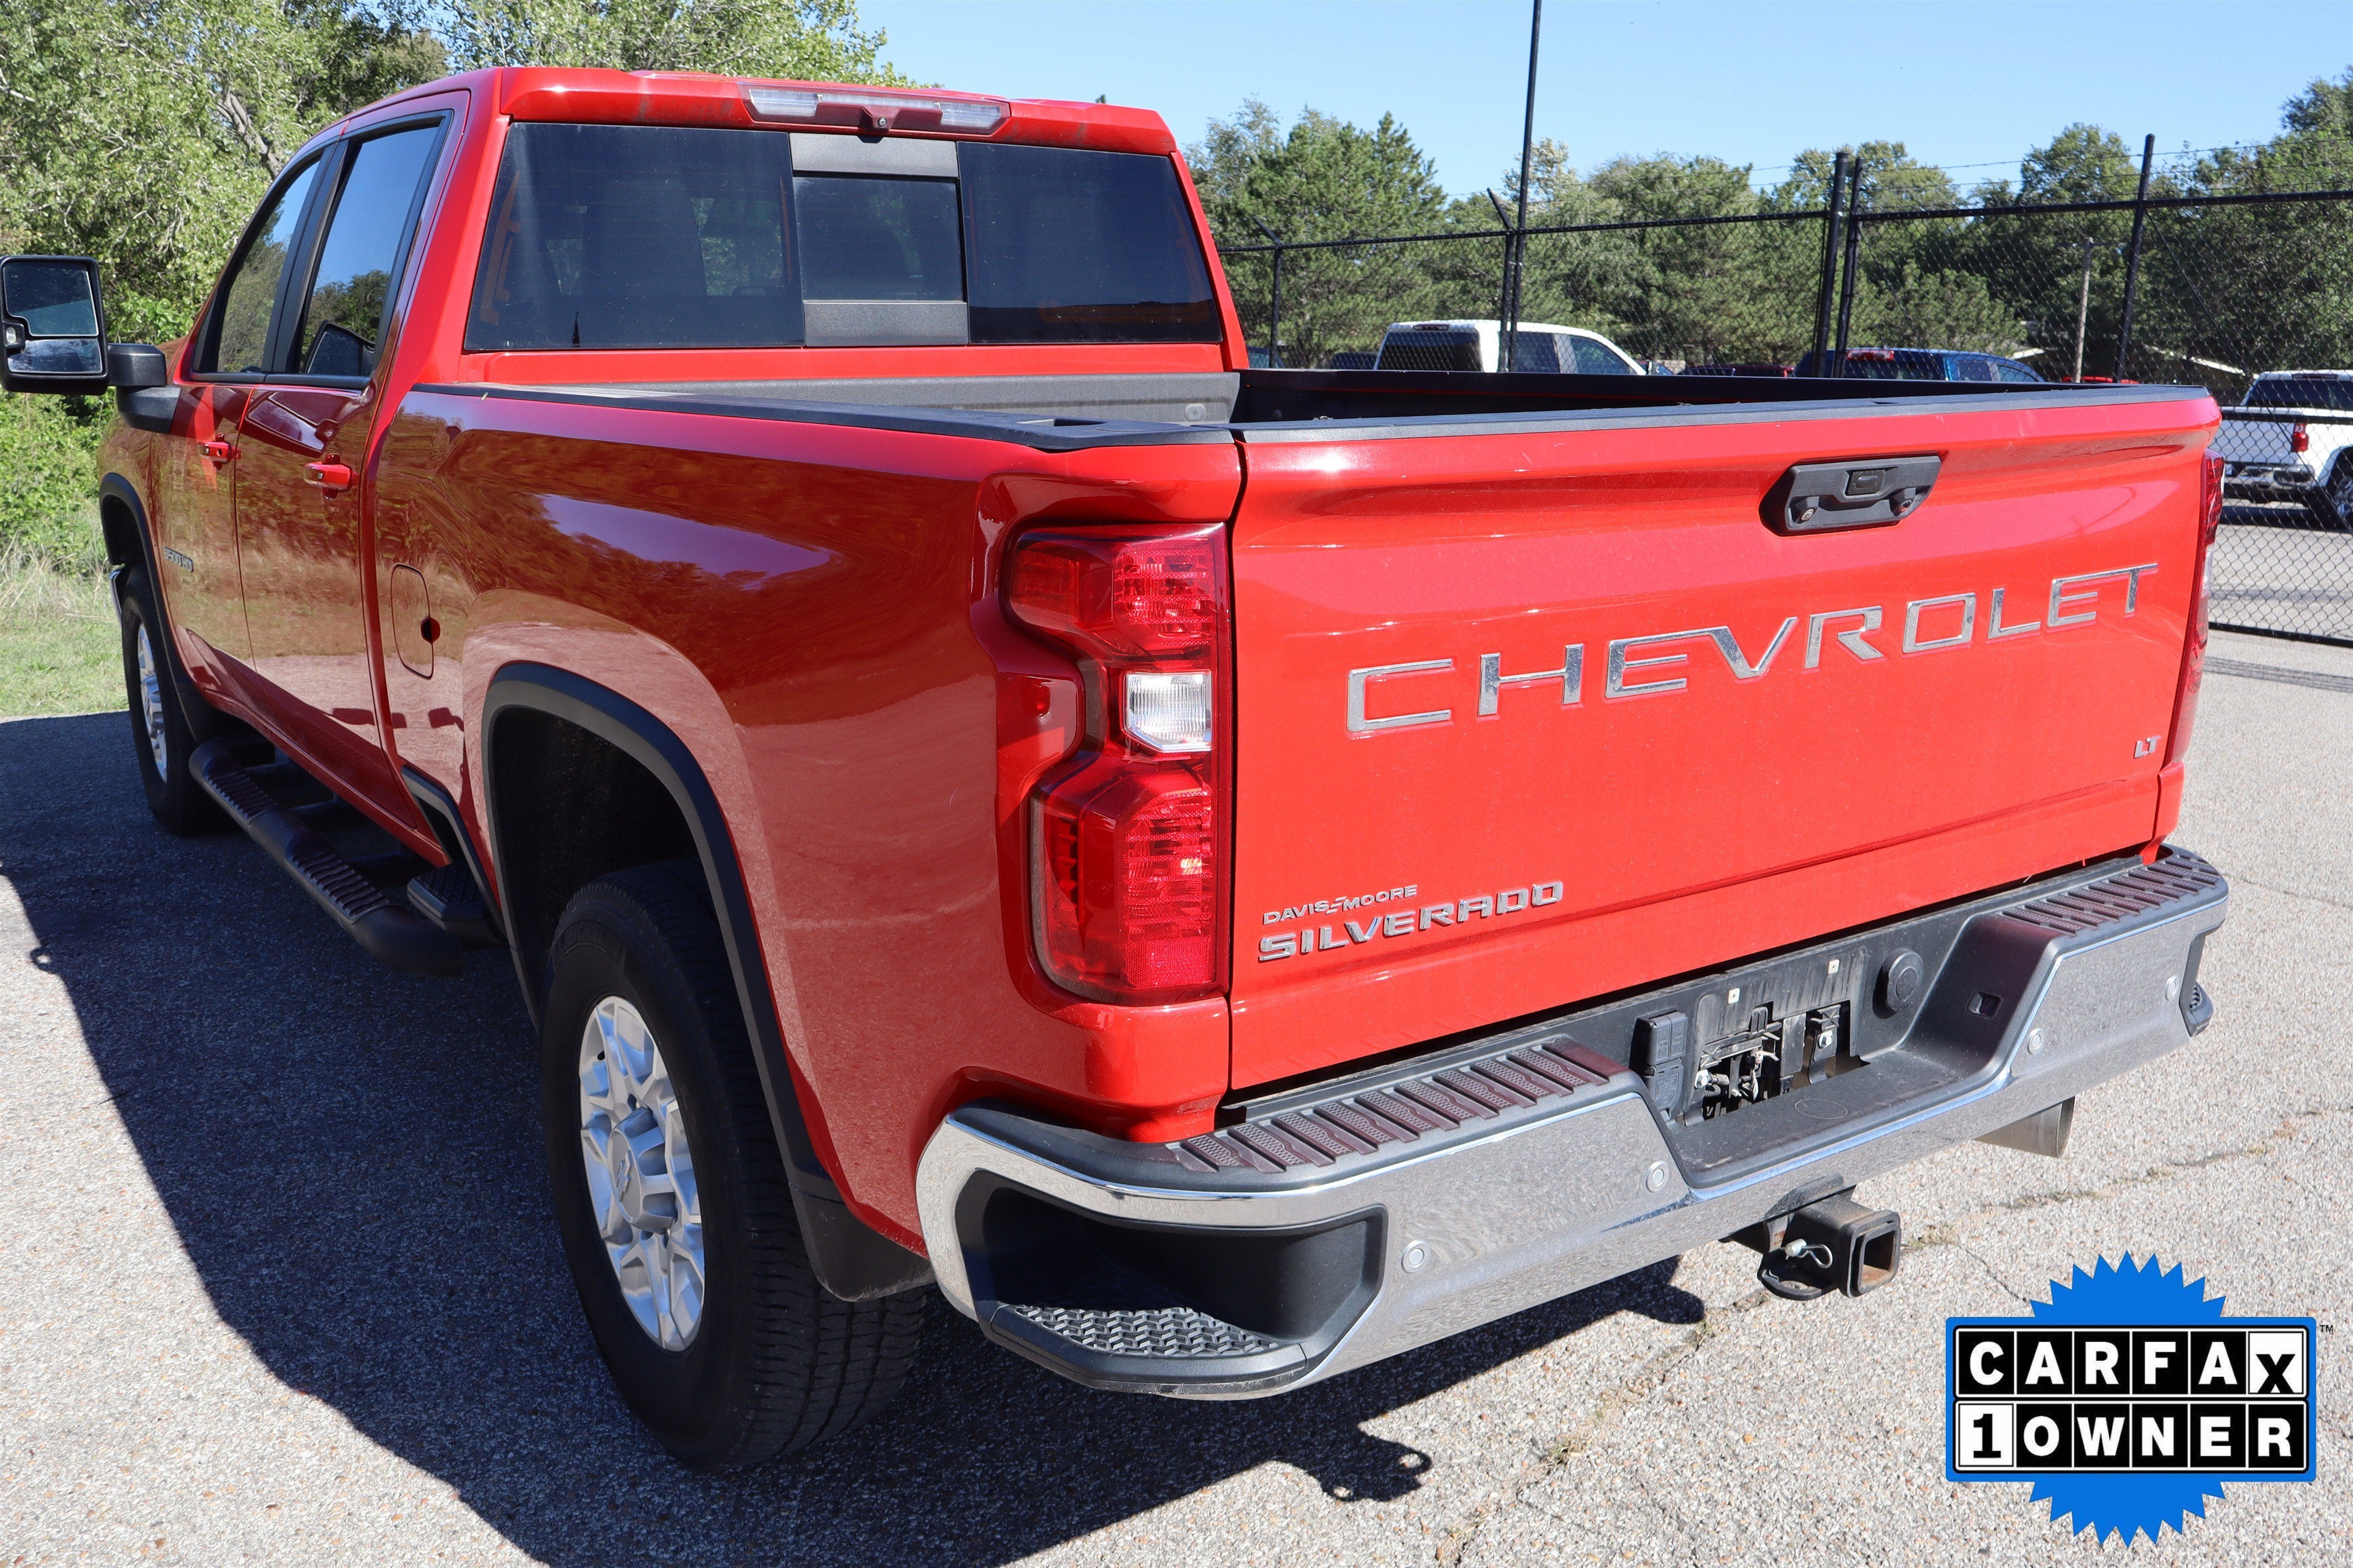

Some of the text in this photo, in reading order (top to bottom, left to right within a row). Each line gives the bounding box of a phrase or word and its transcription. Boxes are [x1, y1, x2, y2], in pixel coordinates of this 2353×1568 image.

[1347, 563, 2158, 736] CHEVROLET
[2133, 735, 2161, 759] LT
[564, 920, 624, 959] MICHELIN
[1258, 880, 1563, 962] SILVERADO
